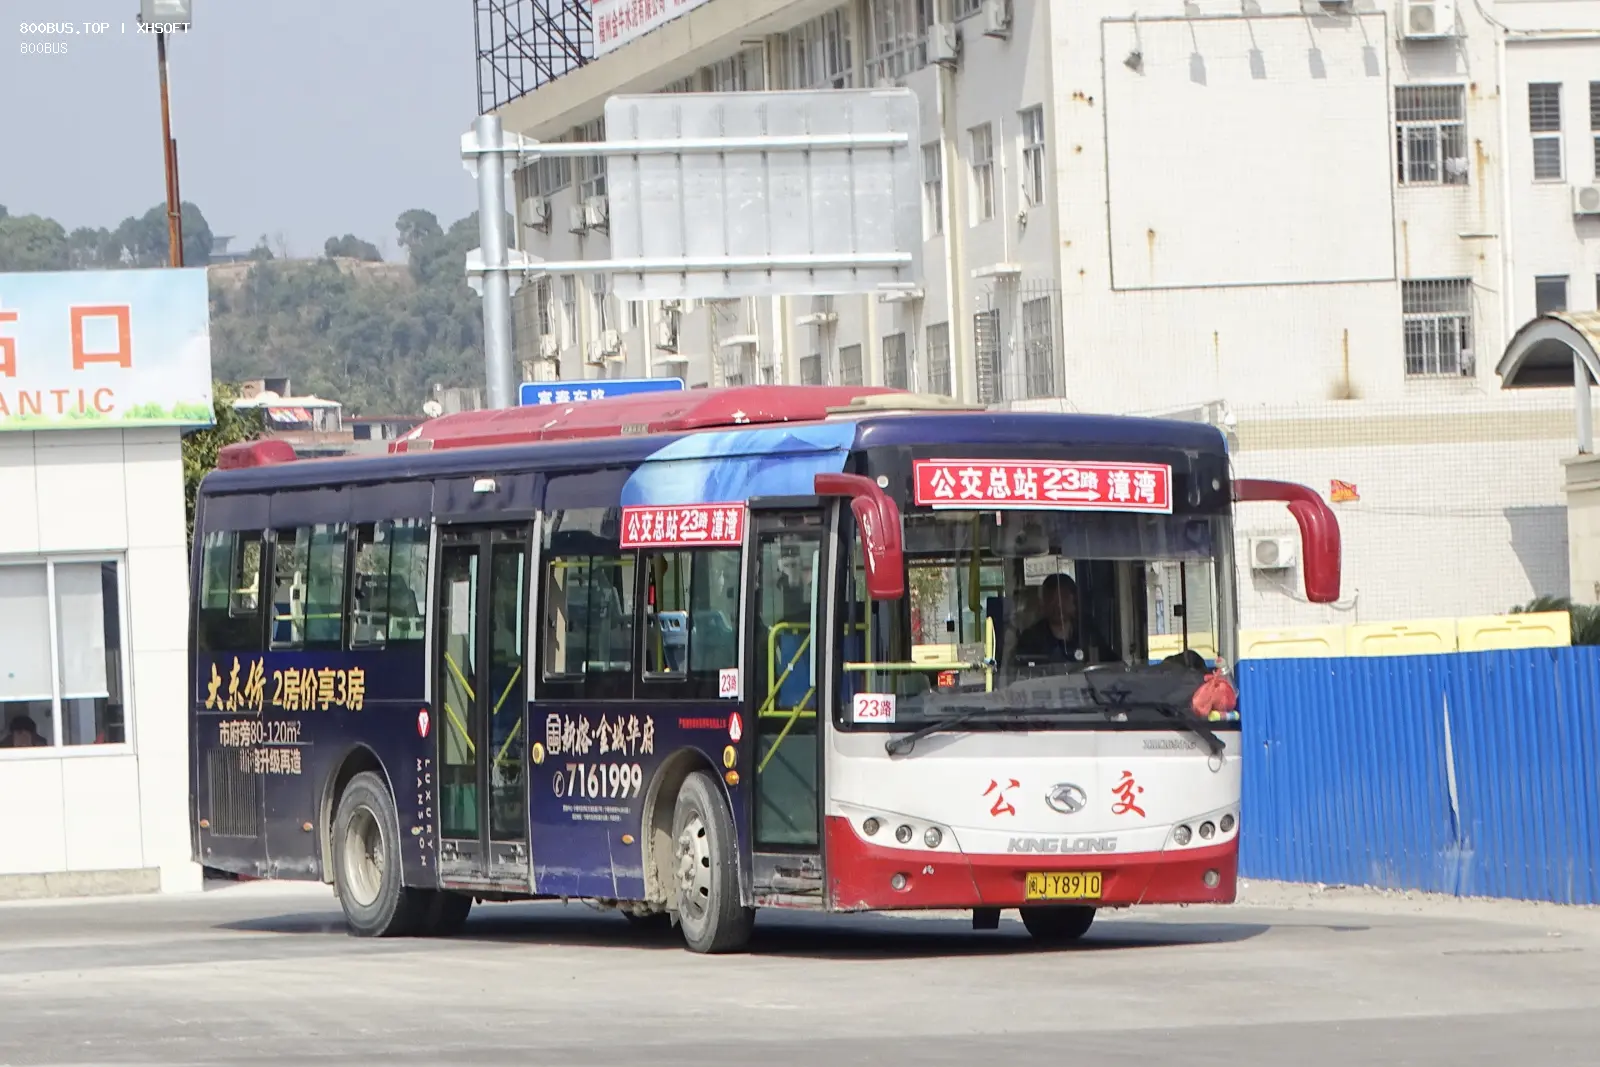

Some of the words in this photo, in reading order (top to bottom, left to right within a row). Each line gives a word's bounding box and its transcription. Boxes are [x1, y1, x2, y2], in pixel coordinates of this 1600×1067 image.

[930, 467, 1038, 499] 公交总站
[1043, 468, 1099, 490] 23路
[1107, 470, 1156, 502] 漳湾
[628, 511, 679, 542] 公交总站
[680, 509, 708, 531] 23路
[711, 508, 738, 540] 漳湾
[272, 666, 365, 711] 2房价享3房
[721, 674, 737, 693] 23路
[858, 699, 892, 717] 23路
[566, 762, 643, 798] 7161999
[981, 777, 1021, 817] 公
[1111, 770, 1146, 818] 交
[416, 758, 426, 866] MANSION
[424, 758, 433, 849] LUXURY
[1007, 837, 1060, 853] KING
[1060, 837, 1118, 852] LONG
